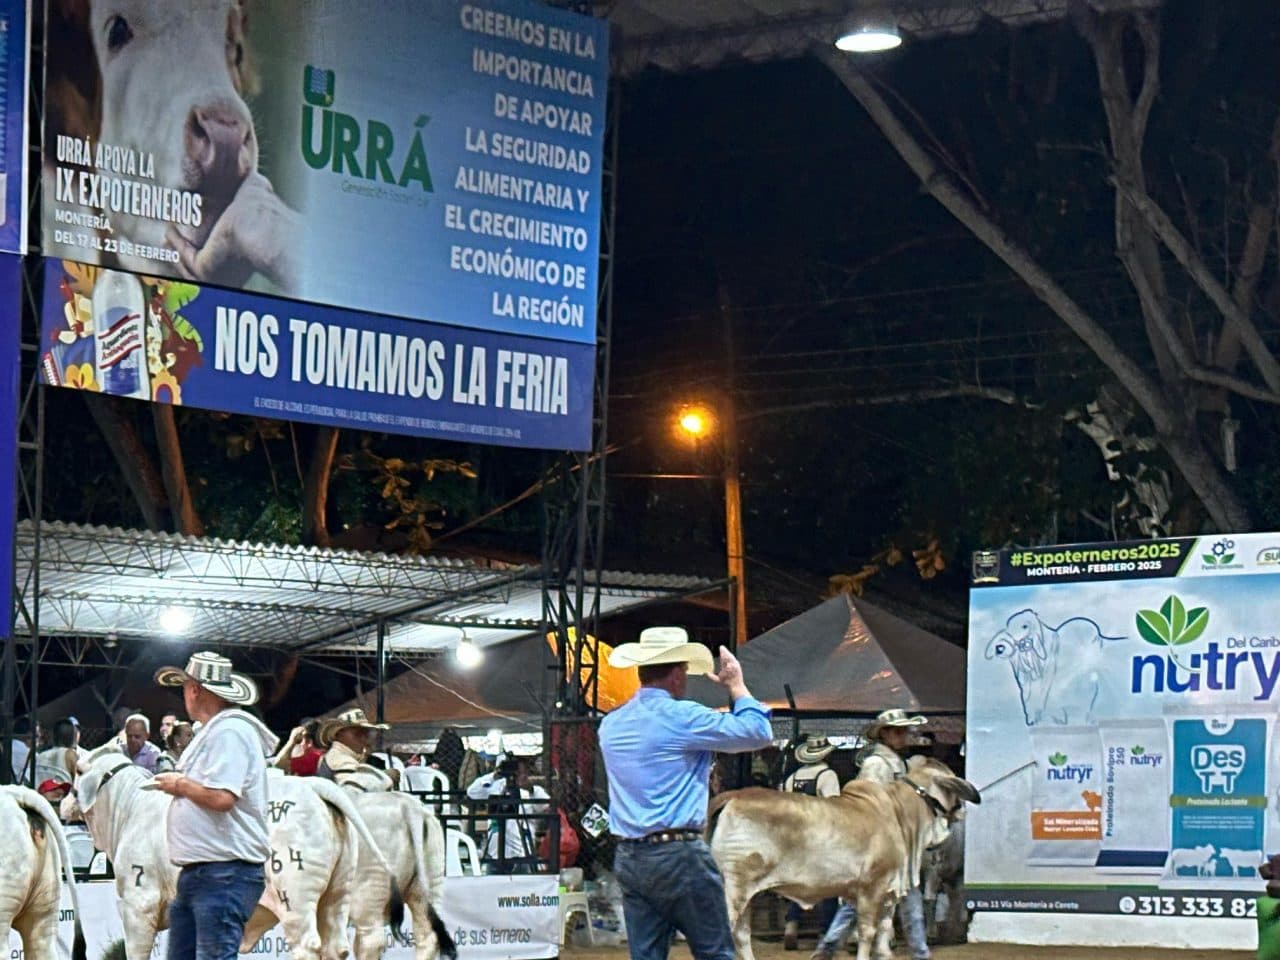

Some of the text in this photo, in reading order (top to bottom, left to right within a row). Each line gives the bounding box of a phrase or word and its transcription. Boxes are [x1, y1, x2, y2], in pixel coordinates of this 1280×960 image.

[461, 5, 595, 59] CREEMOS EN LA
[473, 48, 593, 97] IMPORTANCIA
[495, 93, 592, 136] DE APOYAR
[56, 135, 155, 179] URRÁ APOYA LA
[301, 104, 433, 192] URRÁ
[465, 127, 590, 174] LA SEGURIDAD
[56, 167, 203, 227] IX EXPOTERNEROS
[455, 167, 573, 211] ALIMENTARIA
[577, 189, 589, 213] Y
[445, 204, 588, 252] EL CRECIMIENTO
[54, 230, 74, 245] DEL
[90, 236, 103, 250] AL
[104, 239, 118, 252] 23
[119, 241, 134, 254] DE
[135, 244, 180, 263] FEBRERO
[451, 245, 586, 289] ECONÓMICO DE
[493, 292, 584, 327] LA REGIÓN
[214, 306, 569, 415] NOS TOMAMOS LA FERIA
[1010, 544, 1181, 567] #Expoterneros2025
[1027, 561, 1162, 576] MONTERÍA FEBRERO 2025
[1227, 636, 1246, 648] Del
[1047, 765, 1093, 784] nutryr
[1130, 755, 1162, 768] nutryr
[1194, 747, 1242, 770] Des
[132, 864, 144, 887] 7
[277, 889, 291, 912] 4
[497, 894, 560, 909] www.solla.com
[1138, 896, 1176, 915] 313
[1181, 897, 1224, 916] 333
[470, 929, 487, 945] sus
[490, 926, 532, 945] terneros
